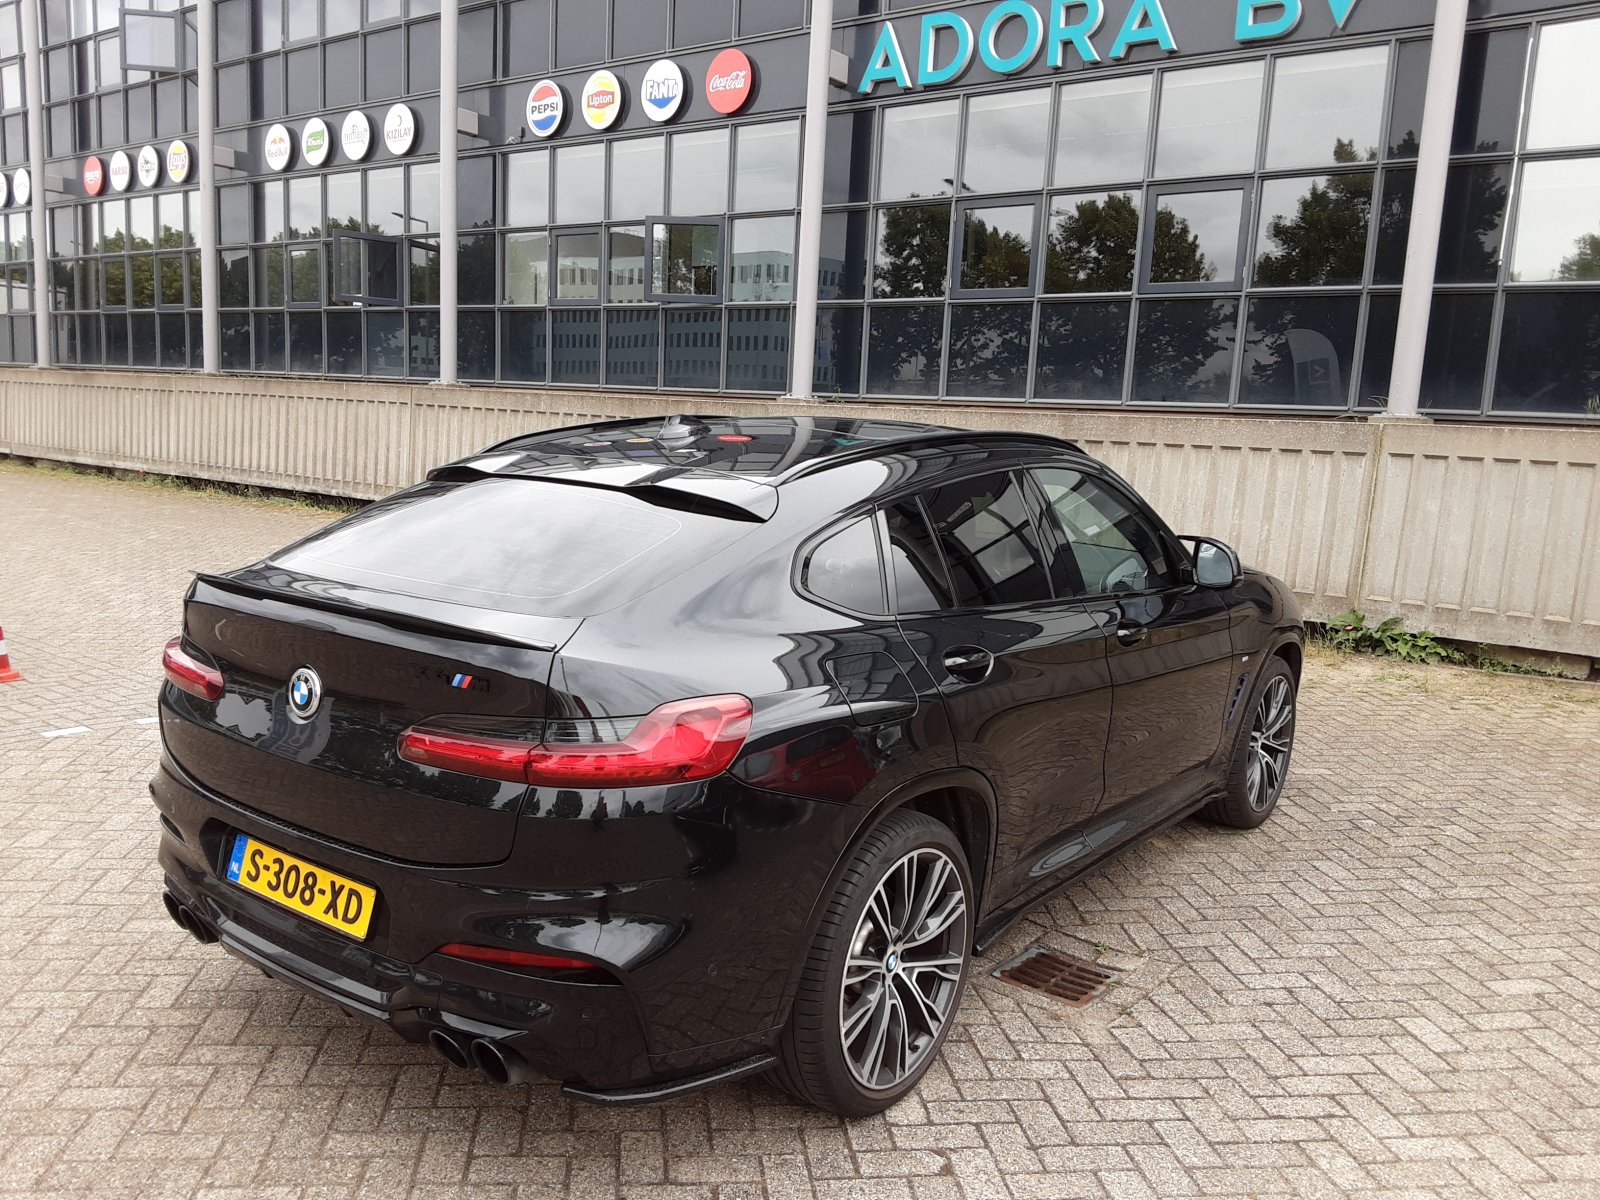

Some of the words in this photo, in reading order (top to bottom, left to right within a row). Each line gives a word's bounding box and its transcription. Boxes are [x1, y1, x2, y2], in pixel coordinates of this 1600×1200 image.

[857, 0, 1179, 95] ADORA
[645, 78, 679, 100] FANTA
[589, 94, 613, 107] Lipton
[530, 103, 559, 115] PEPSI
[386, 127, 412, 141] KIZILAY
[230, 861, 240, 874] NL
[246, 848, 363, 925] S-308-XD
